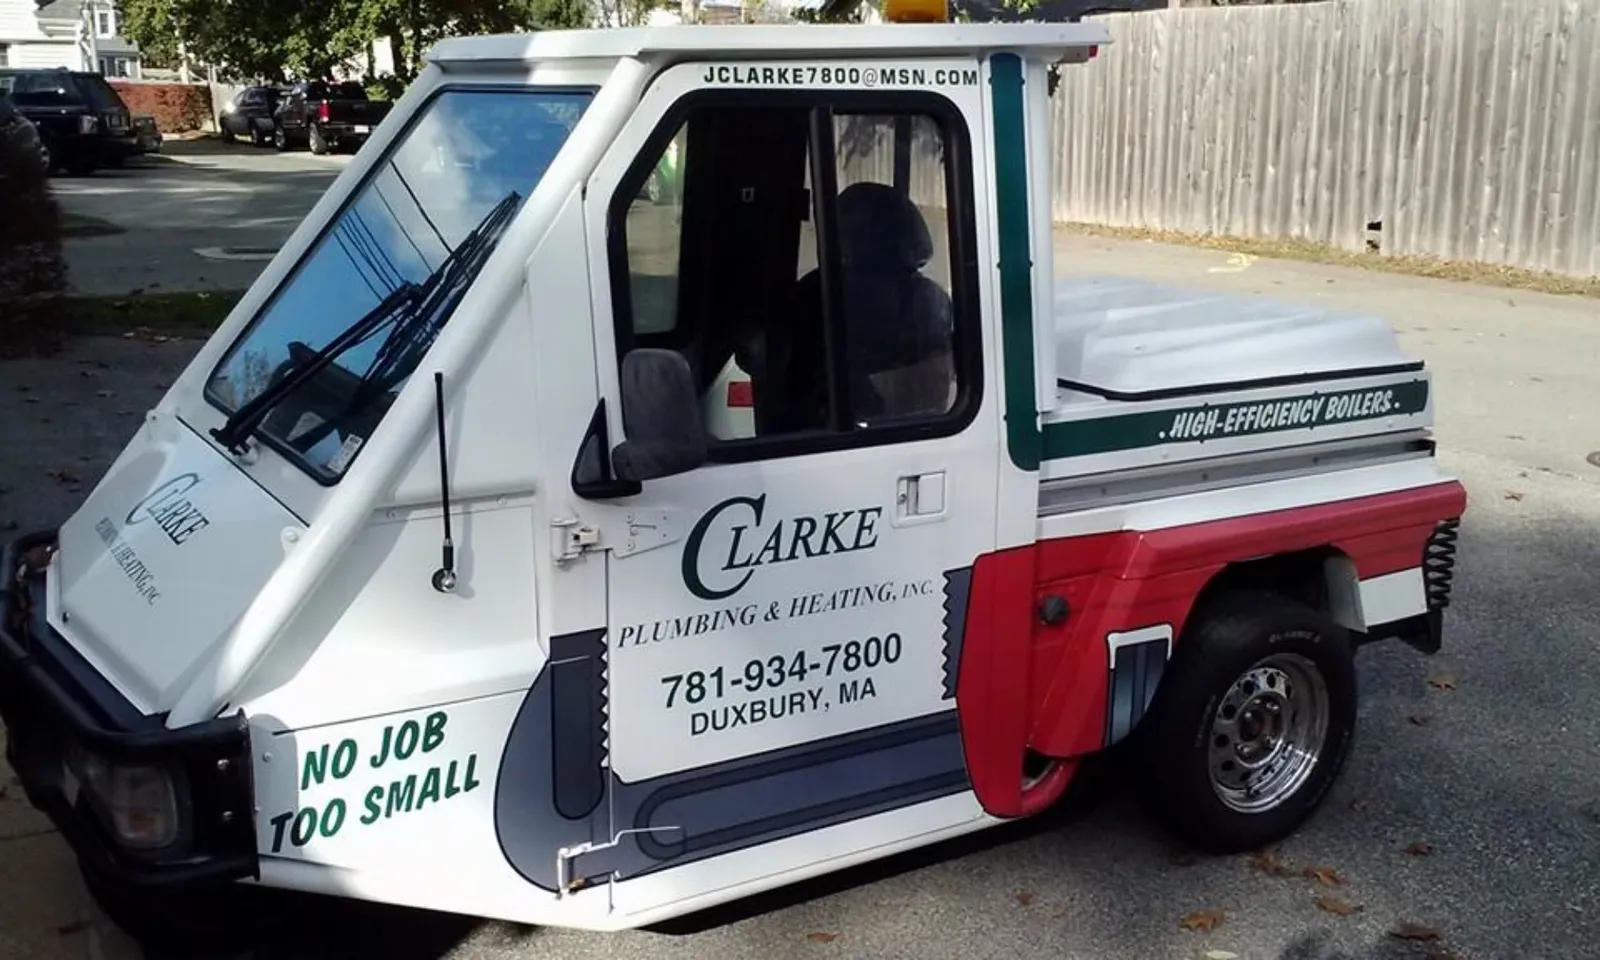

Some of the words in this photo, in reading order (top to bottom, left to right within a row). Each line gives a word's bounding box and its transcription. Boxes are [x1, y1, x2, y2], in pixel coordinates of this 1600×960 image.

[703, 66, 978, 87] JCLARKE7800@MSN.COM
[125, 472, 209, 546] CLARKE
[681, 493, 882, 601] CLARKE
[617, 605, 758, 649] PLUMBING
[763, 601, 781, 622] &
[788, 581, 897, 618] HEATING,
[902, 579, 933, 599] INC.
[661, 632, 902, 709] 781-934-7800
[690, 687, 830, 736] DUXBURY,
[838, 677, 876, 704] MA
[301, 738, 358, 791] NO
[370, 711, 448, 768] JOB
[270, 798, 347, 853] TOO
[359, 754, 480, 825] SMALL
